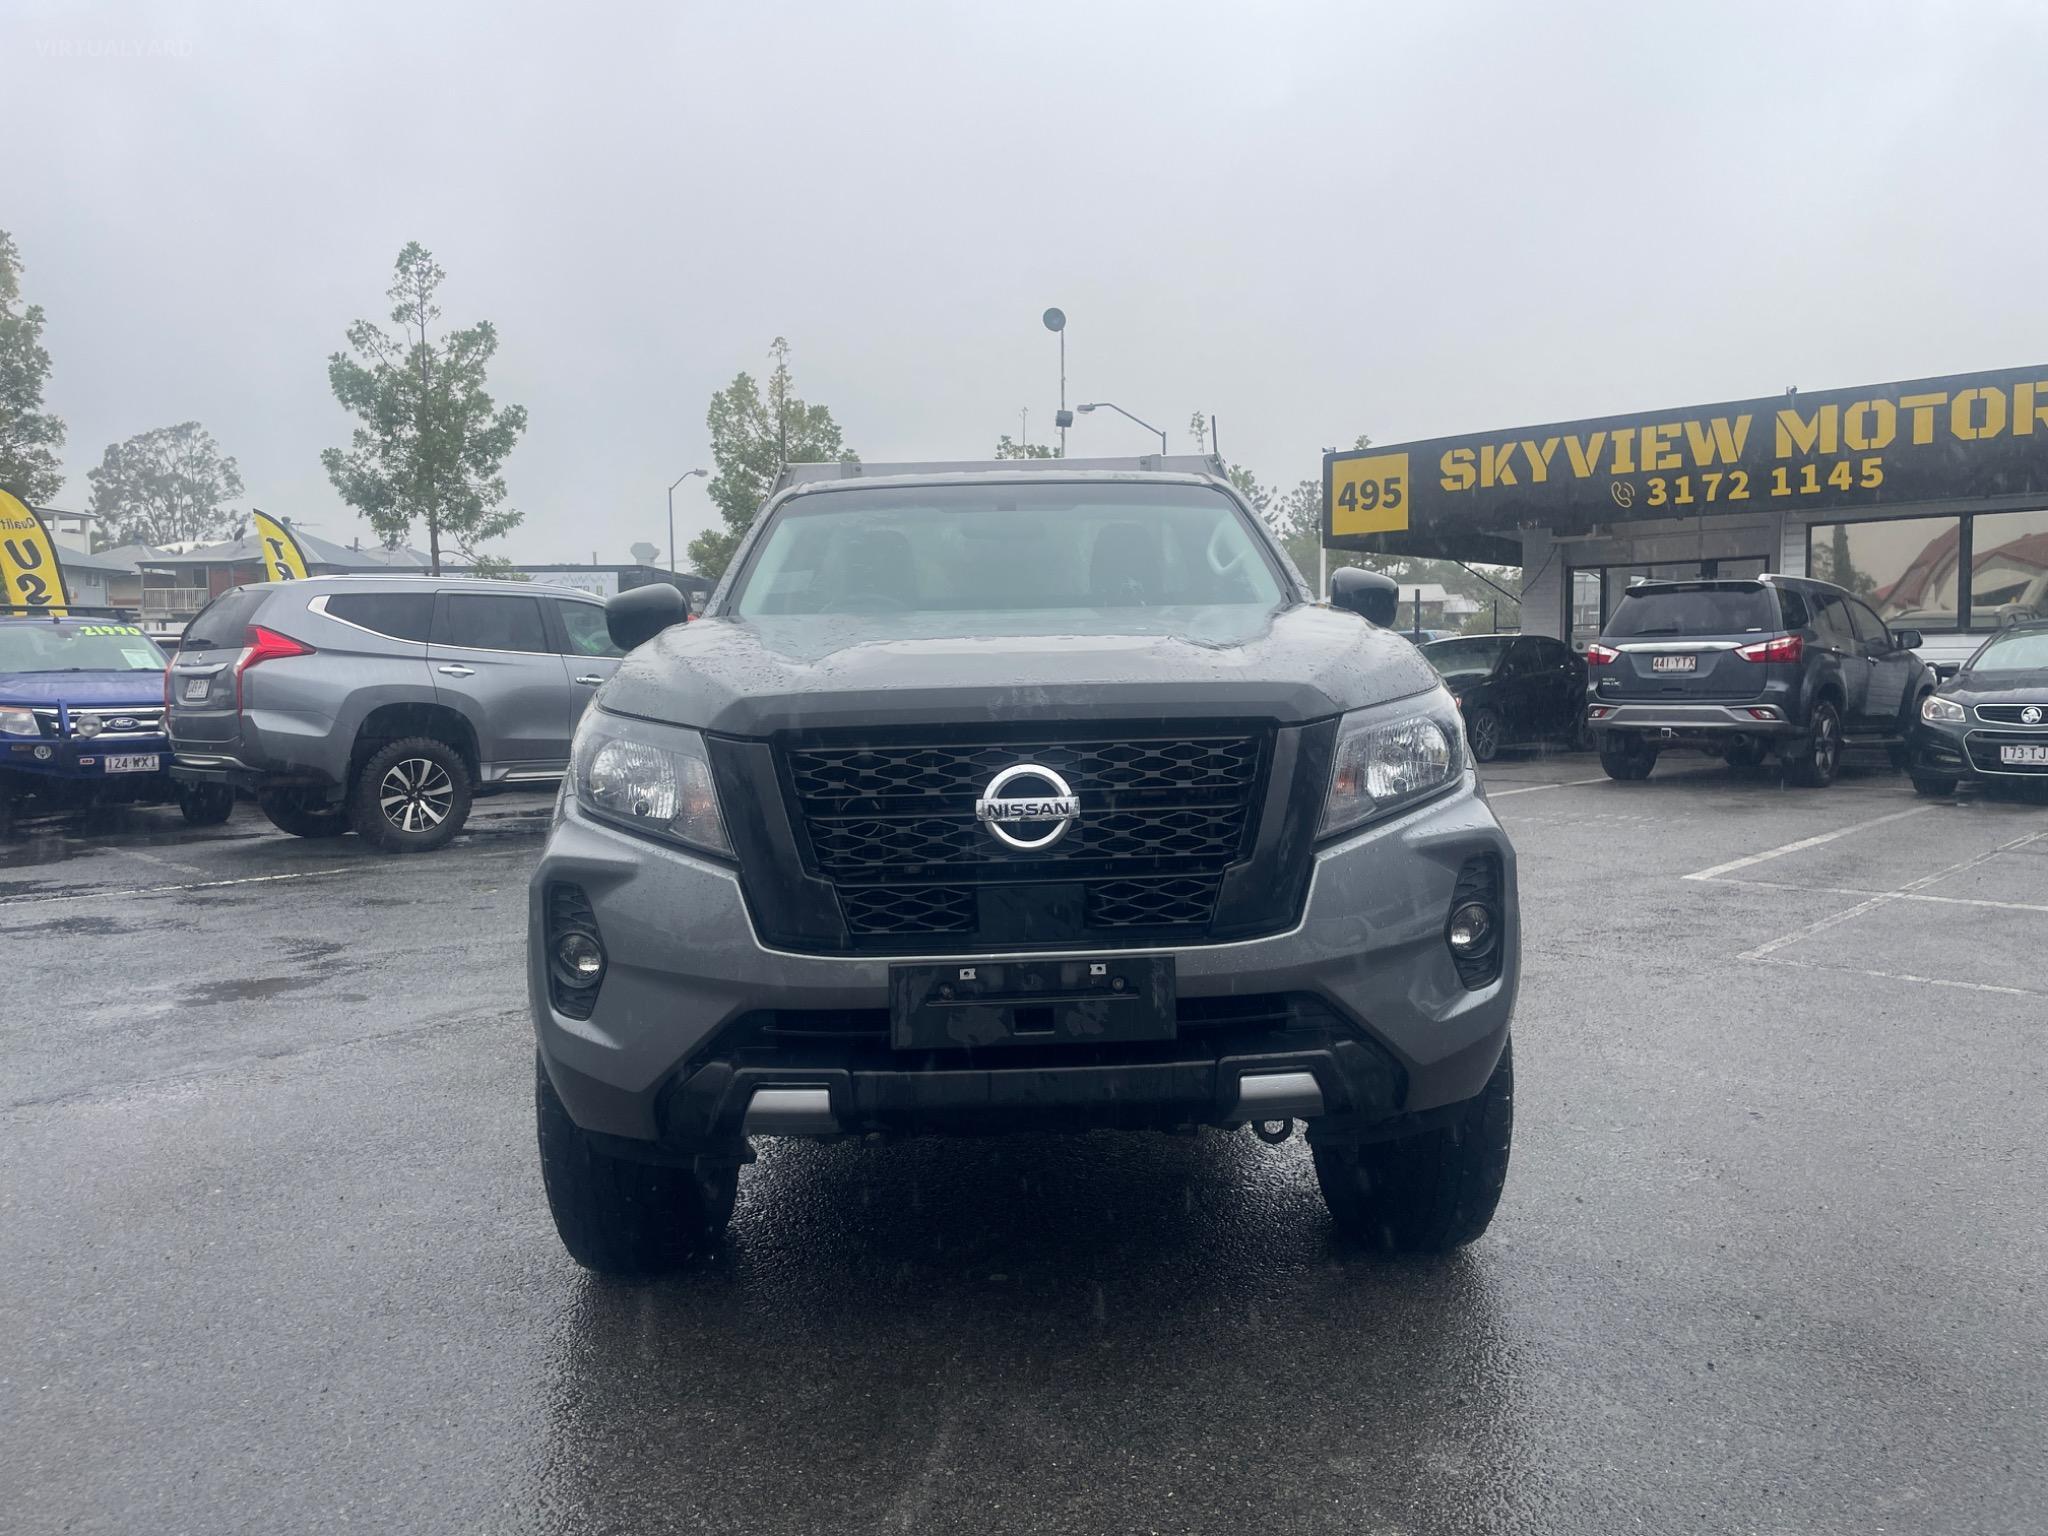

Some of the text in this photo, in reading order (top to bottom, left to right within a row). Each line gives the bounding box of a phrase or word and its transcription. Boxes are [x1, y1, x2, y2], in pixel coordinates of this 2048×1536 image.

[1439, 414, 1753, 492] SKYVIEW
[1337, 476, 1403, 512] 495
[1647, 457, 1885, 507] 3172 1145
[80, 625, 144, 636] 21990
[987, 801, 1070, 818] NISSAN
